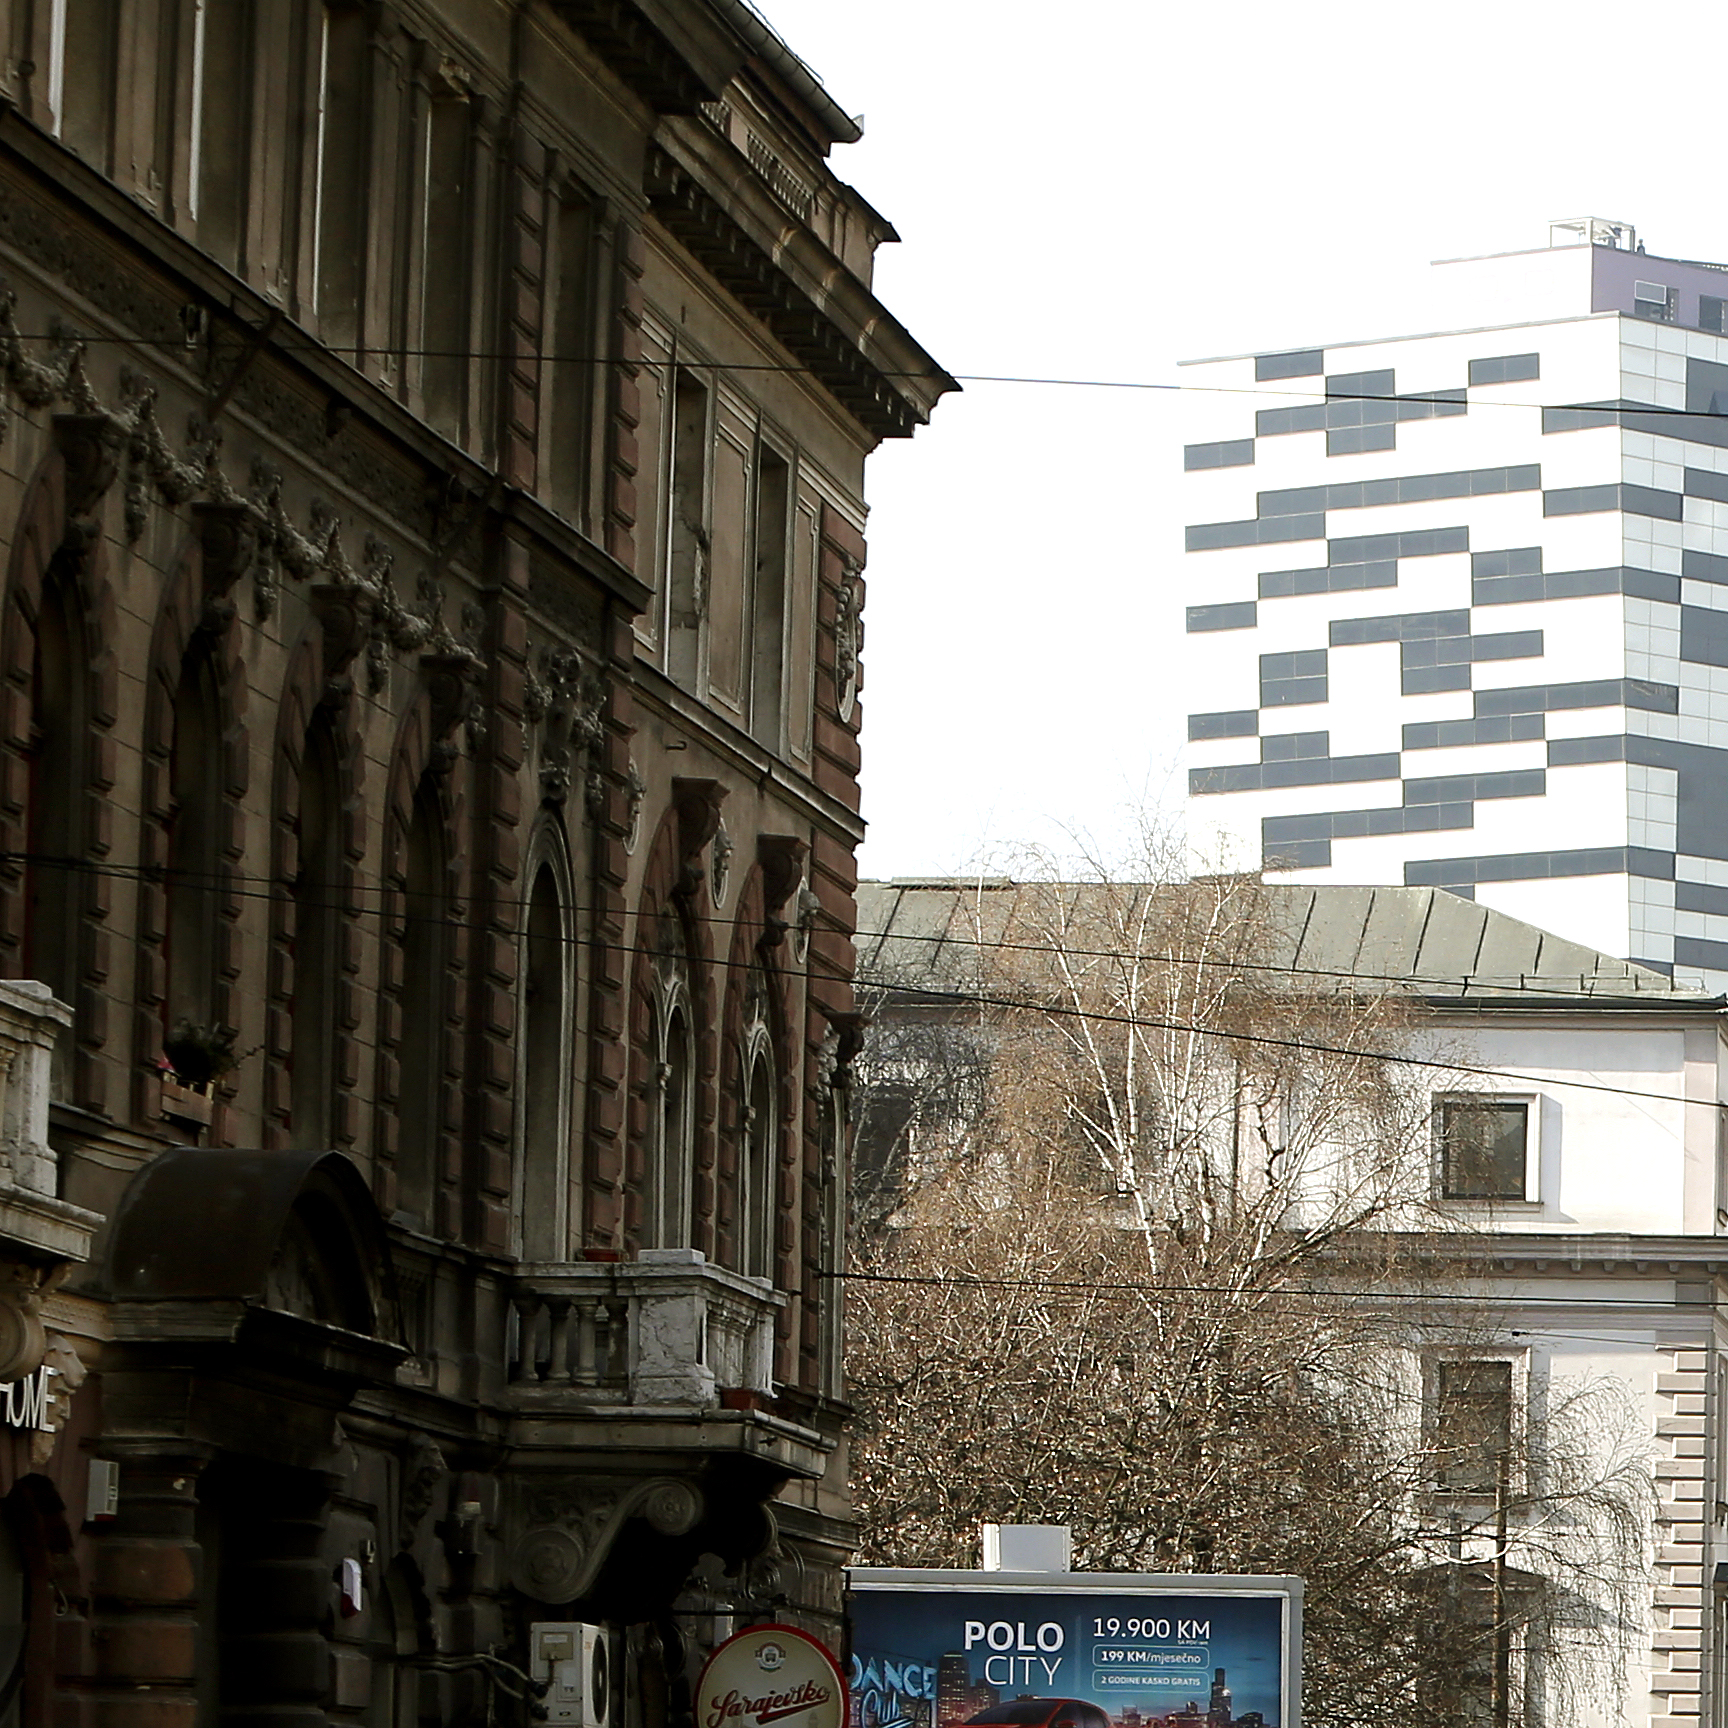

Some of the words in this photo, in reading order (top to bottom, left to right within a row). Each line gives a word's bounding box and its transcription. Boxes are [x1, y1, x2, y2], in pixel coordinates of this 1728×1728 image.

[964, 1621, 1065, 1653] POLO
[1093, 1617, 1171, 1639] 19.900
[1177, 1619, 1210, 1639] KM
[1101, 1650, 1125, 1662] 199
[984, 1656, 1064, 1686] CITY
[1101, 1675, 1107, 1684] 2
[1108, 1676, 1140, 1685] GODINE
[1141, 1676, 1171, 1685] KASKO
[1171, 1677, 1201, 1686] GRATIS
[707, 1680, 831, 1728] Sarajevsko
